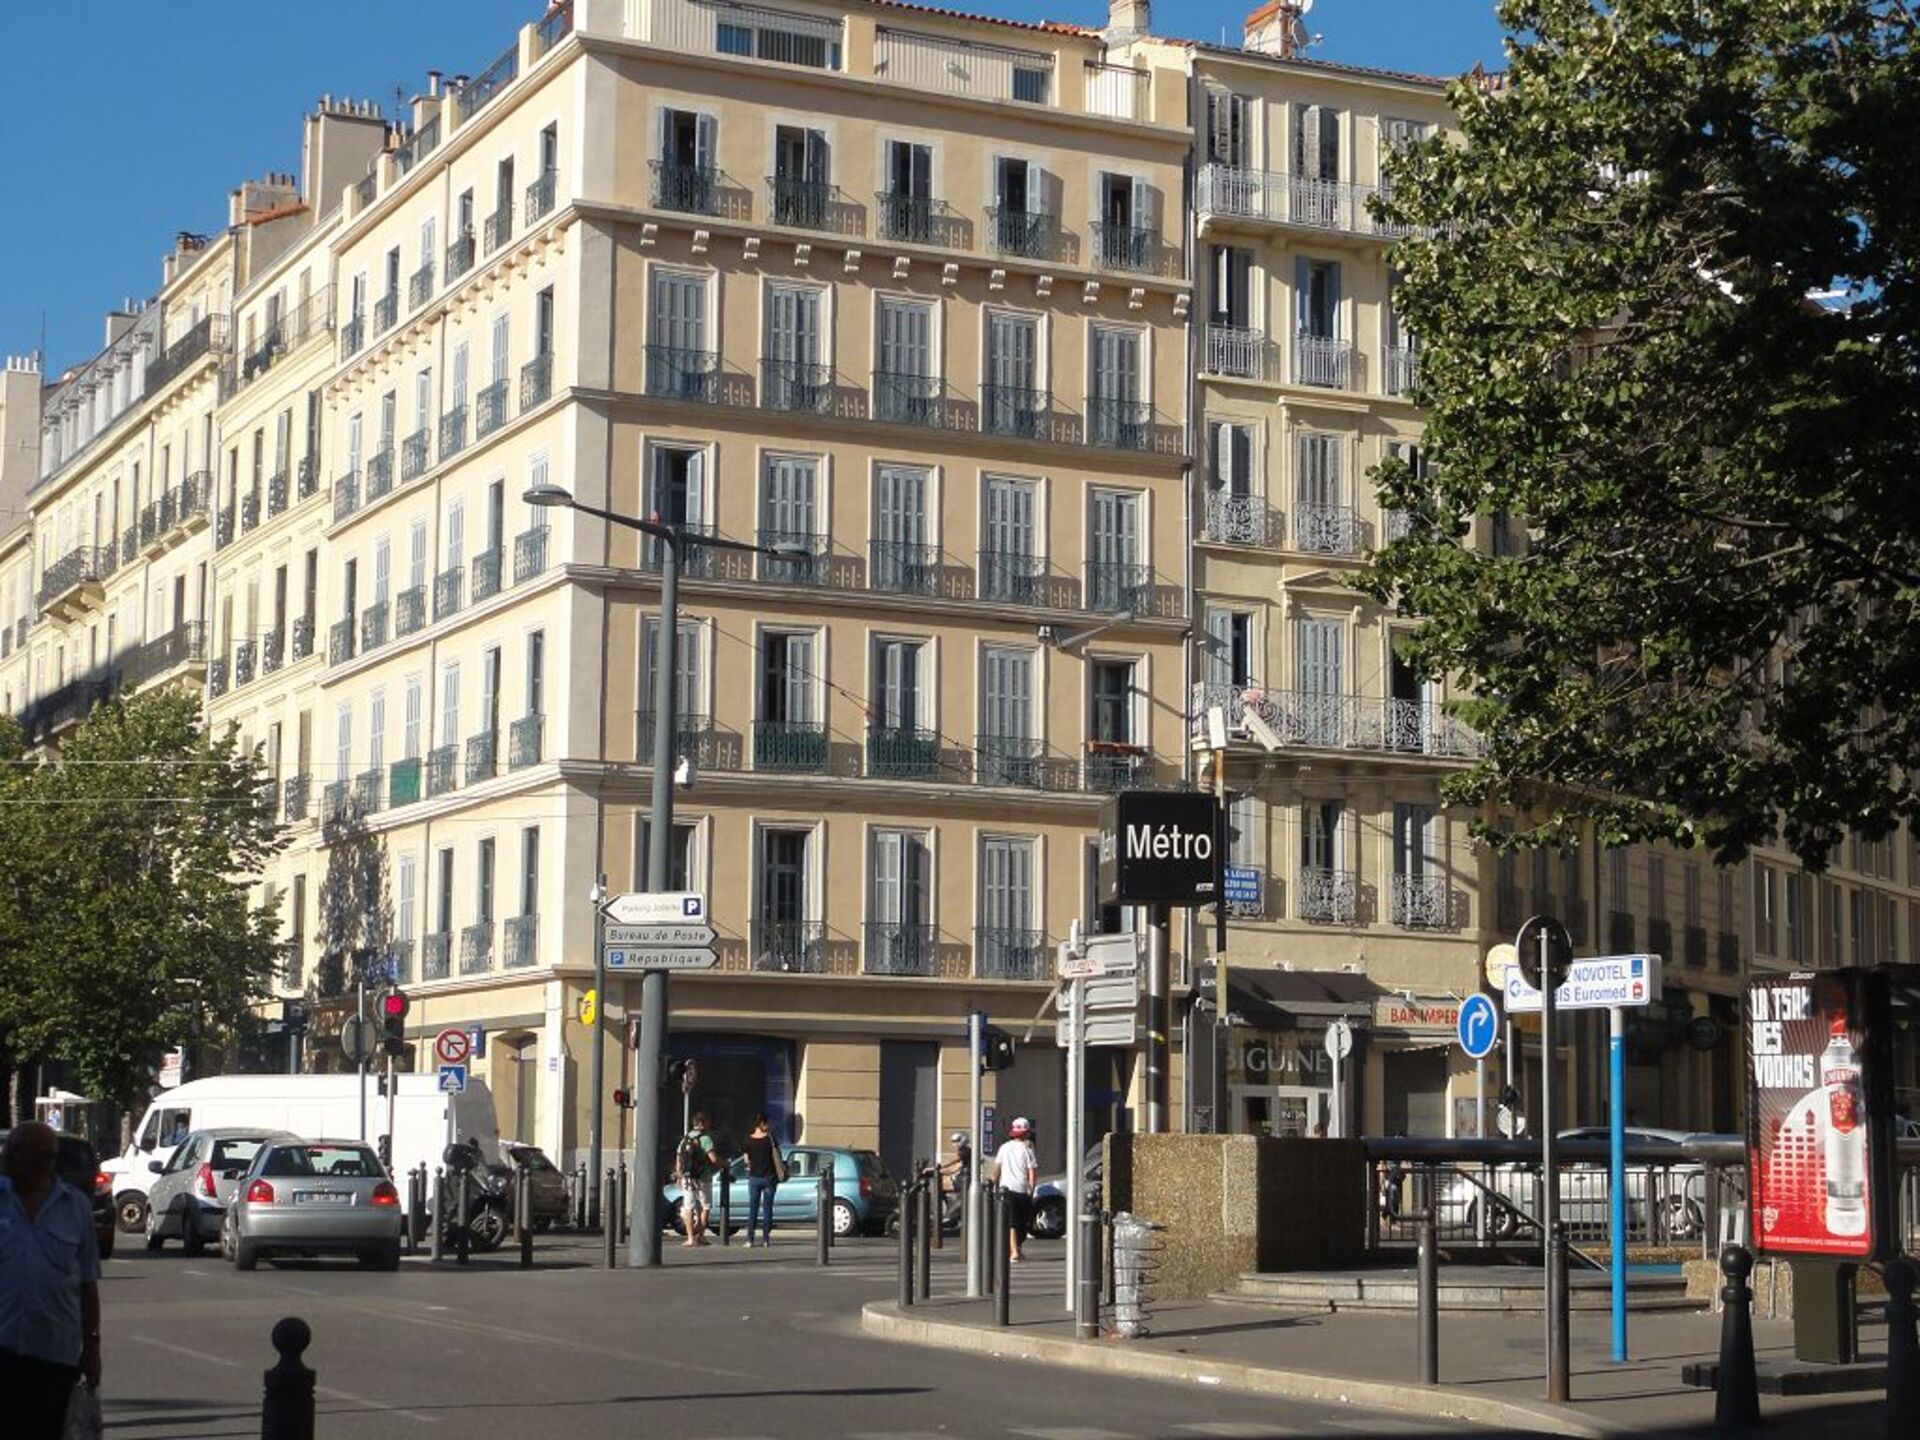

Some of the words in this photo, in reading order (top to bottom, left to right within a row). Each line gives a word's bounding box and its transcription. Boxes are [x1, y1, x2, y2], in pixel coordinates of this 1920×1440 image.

[1126, 823, 1212, 860] Métro
[610, 930, 649, 940] Bureau
[655, 930, 668, 940] de
[674, 930, 706, 941] Poste
[628, 953, 702, 965] République
[1573, 964, 1628, 982] NOVOTEL
[1574, 983, 1627, 1002] Euromed
[1391, 1008, 1416, 1022] BAR
[1420, 1008, 1458, 1024] IMPER
[1753, 1022, 1782, 1054] DES
